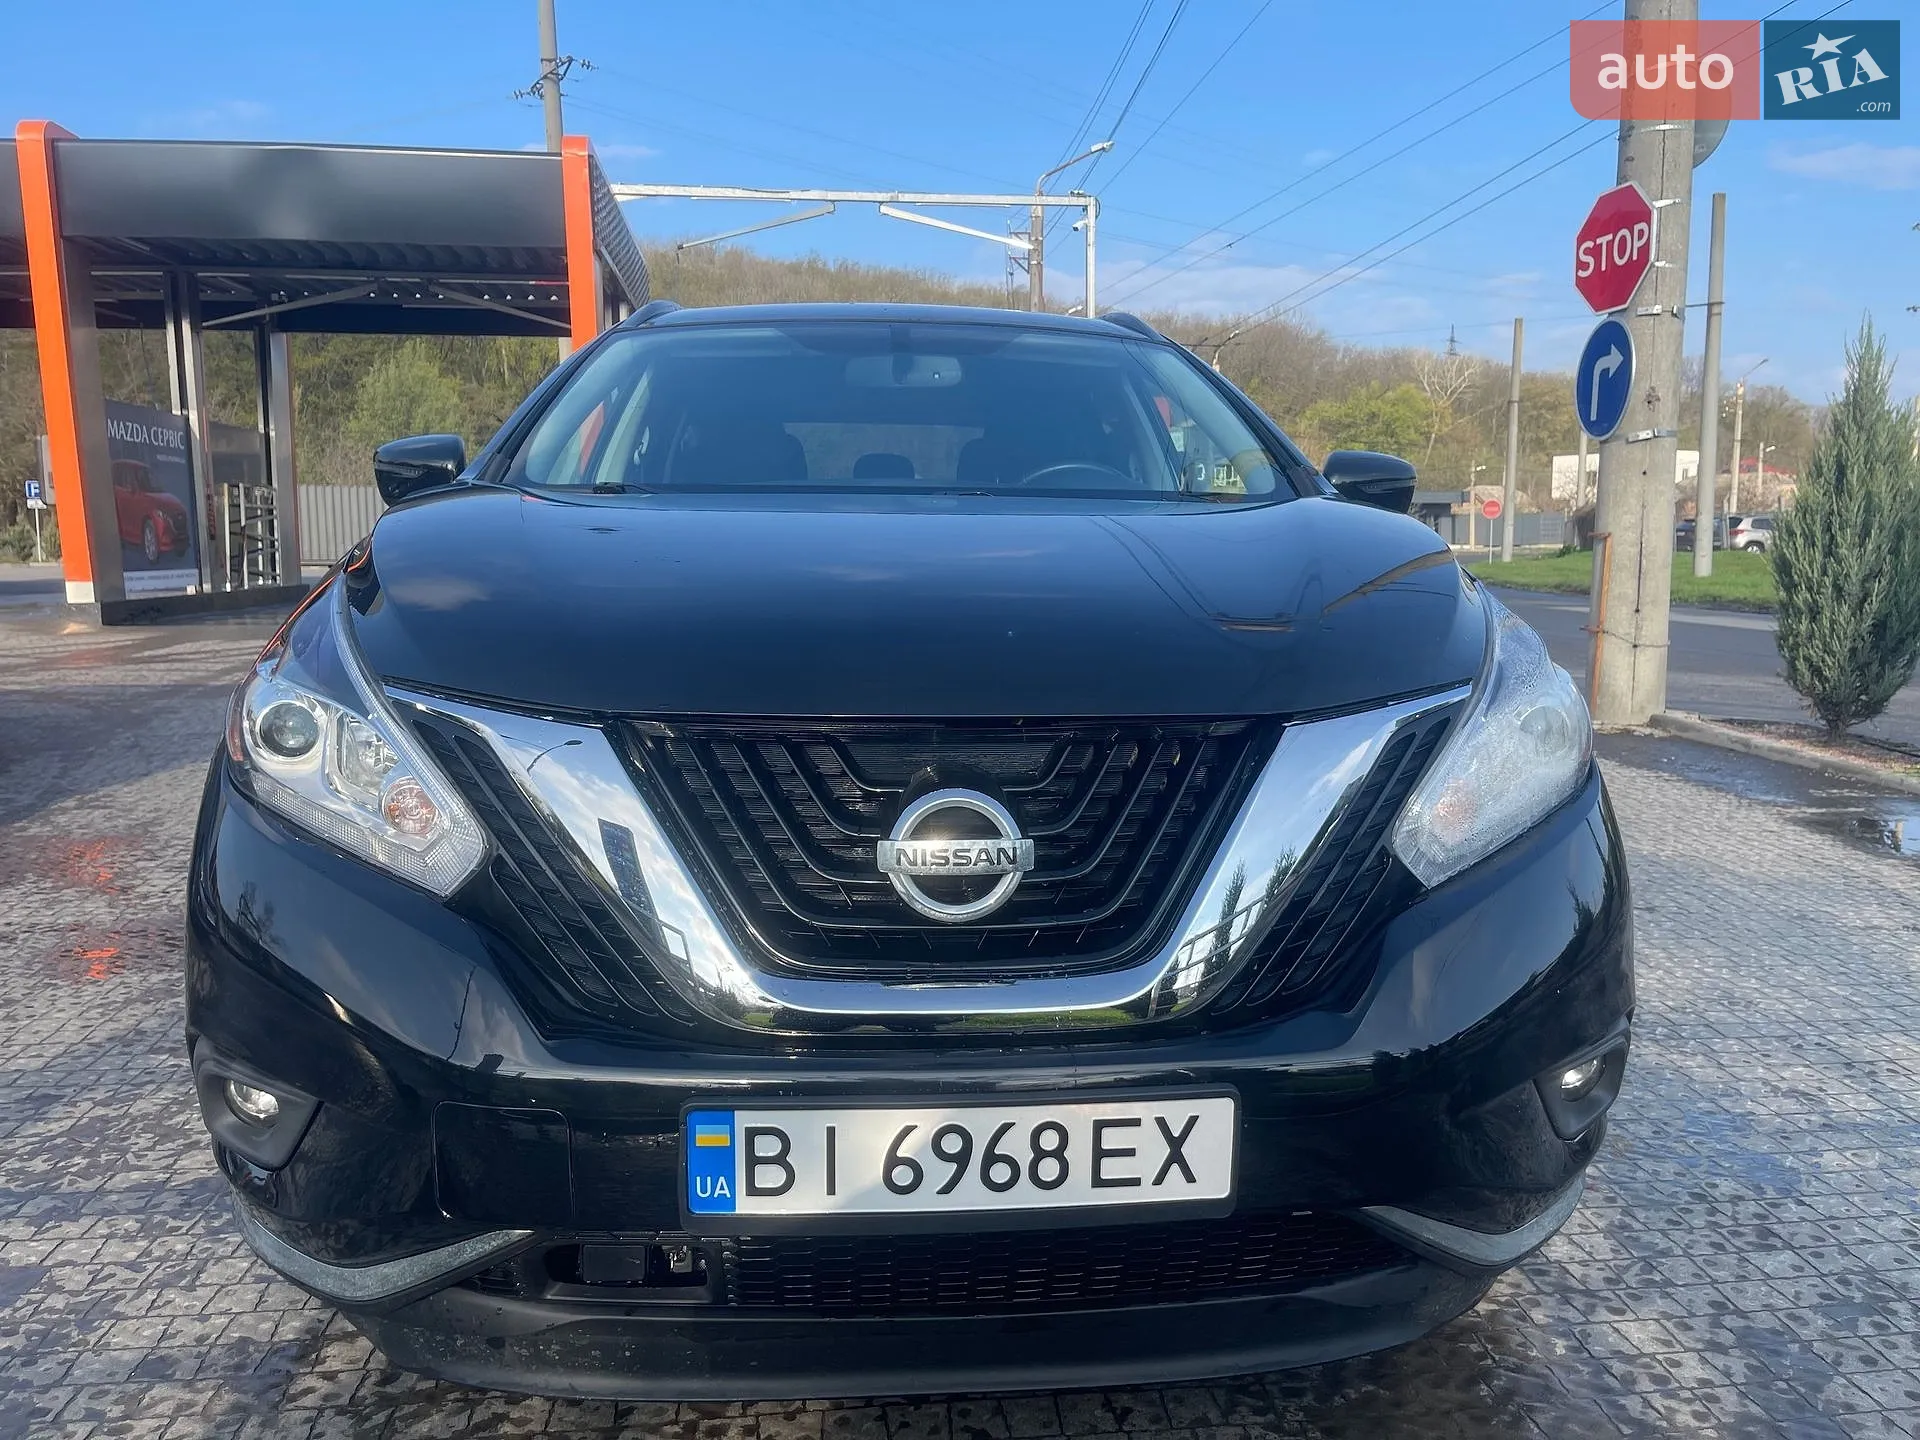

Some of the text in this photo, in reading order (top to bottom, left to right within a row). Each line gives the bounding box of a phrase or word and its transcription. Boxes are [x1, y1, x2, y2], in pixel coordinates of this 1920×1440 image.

[1577, 222, 1649, 278] STOP
[107, 418, 185, 450] MAZDA СЕРВІС
[895, 847, 1018, 867] NISSAN
[882, 1120, 1070, 1196] 6968
[1090, 1115, 1200, 1188] EX
[696, 1176, 731, 1198] UA
